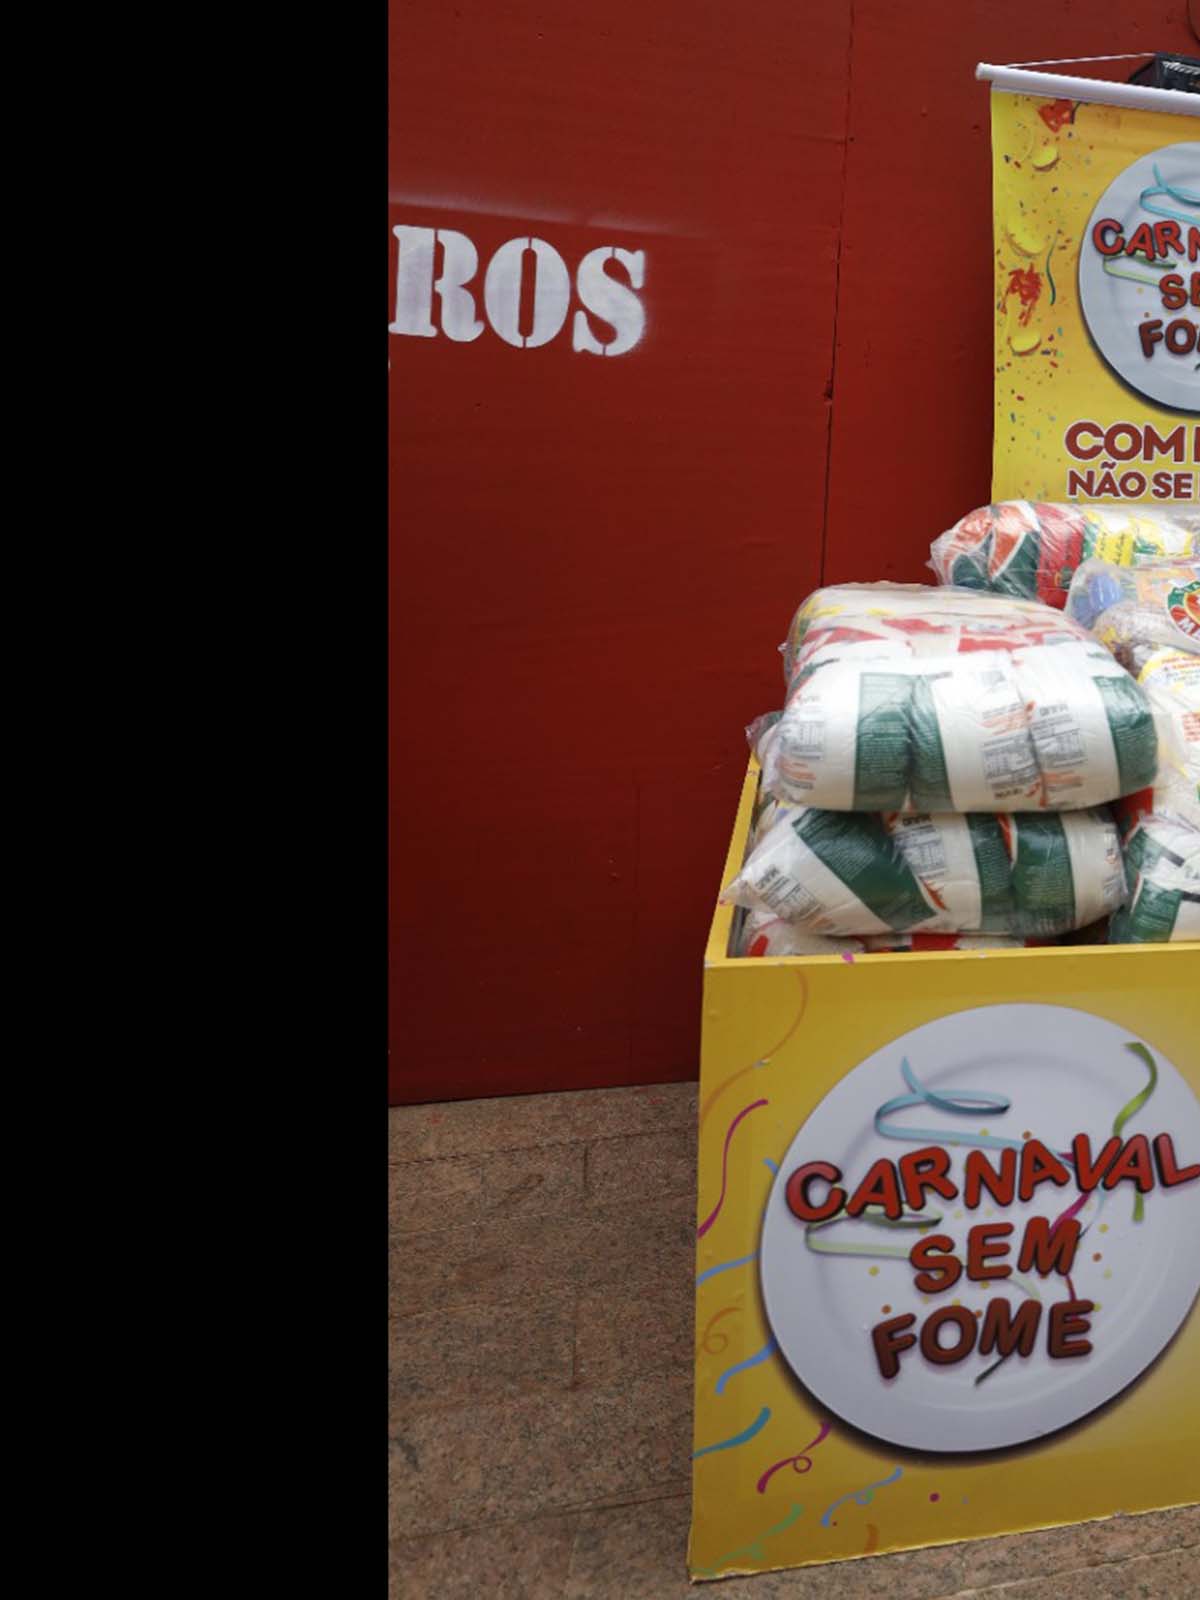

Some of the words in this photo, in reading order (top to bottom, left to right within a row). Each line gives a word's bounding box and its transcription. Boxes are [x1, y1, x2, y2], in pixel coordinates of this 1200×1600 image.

[389, 225, 645, 357] ROS
[1066, 422, 1186, 461] COM
[1068, 461, 1146, 498] NÃO
[1152, 471, 1192, 499] SE
[909, 1216, 1081, 1294] SEM
[870, 1298, 1094, 1380] FOME
